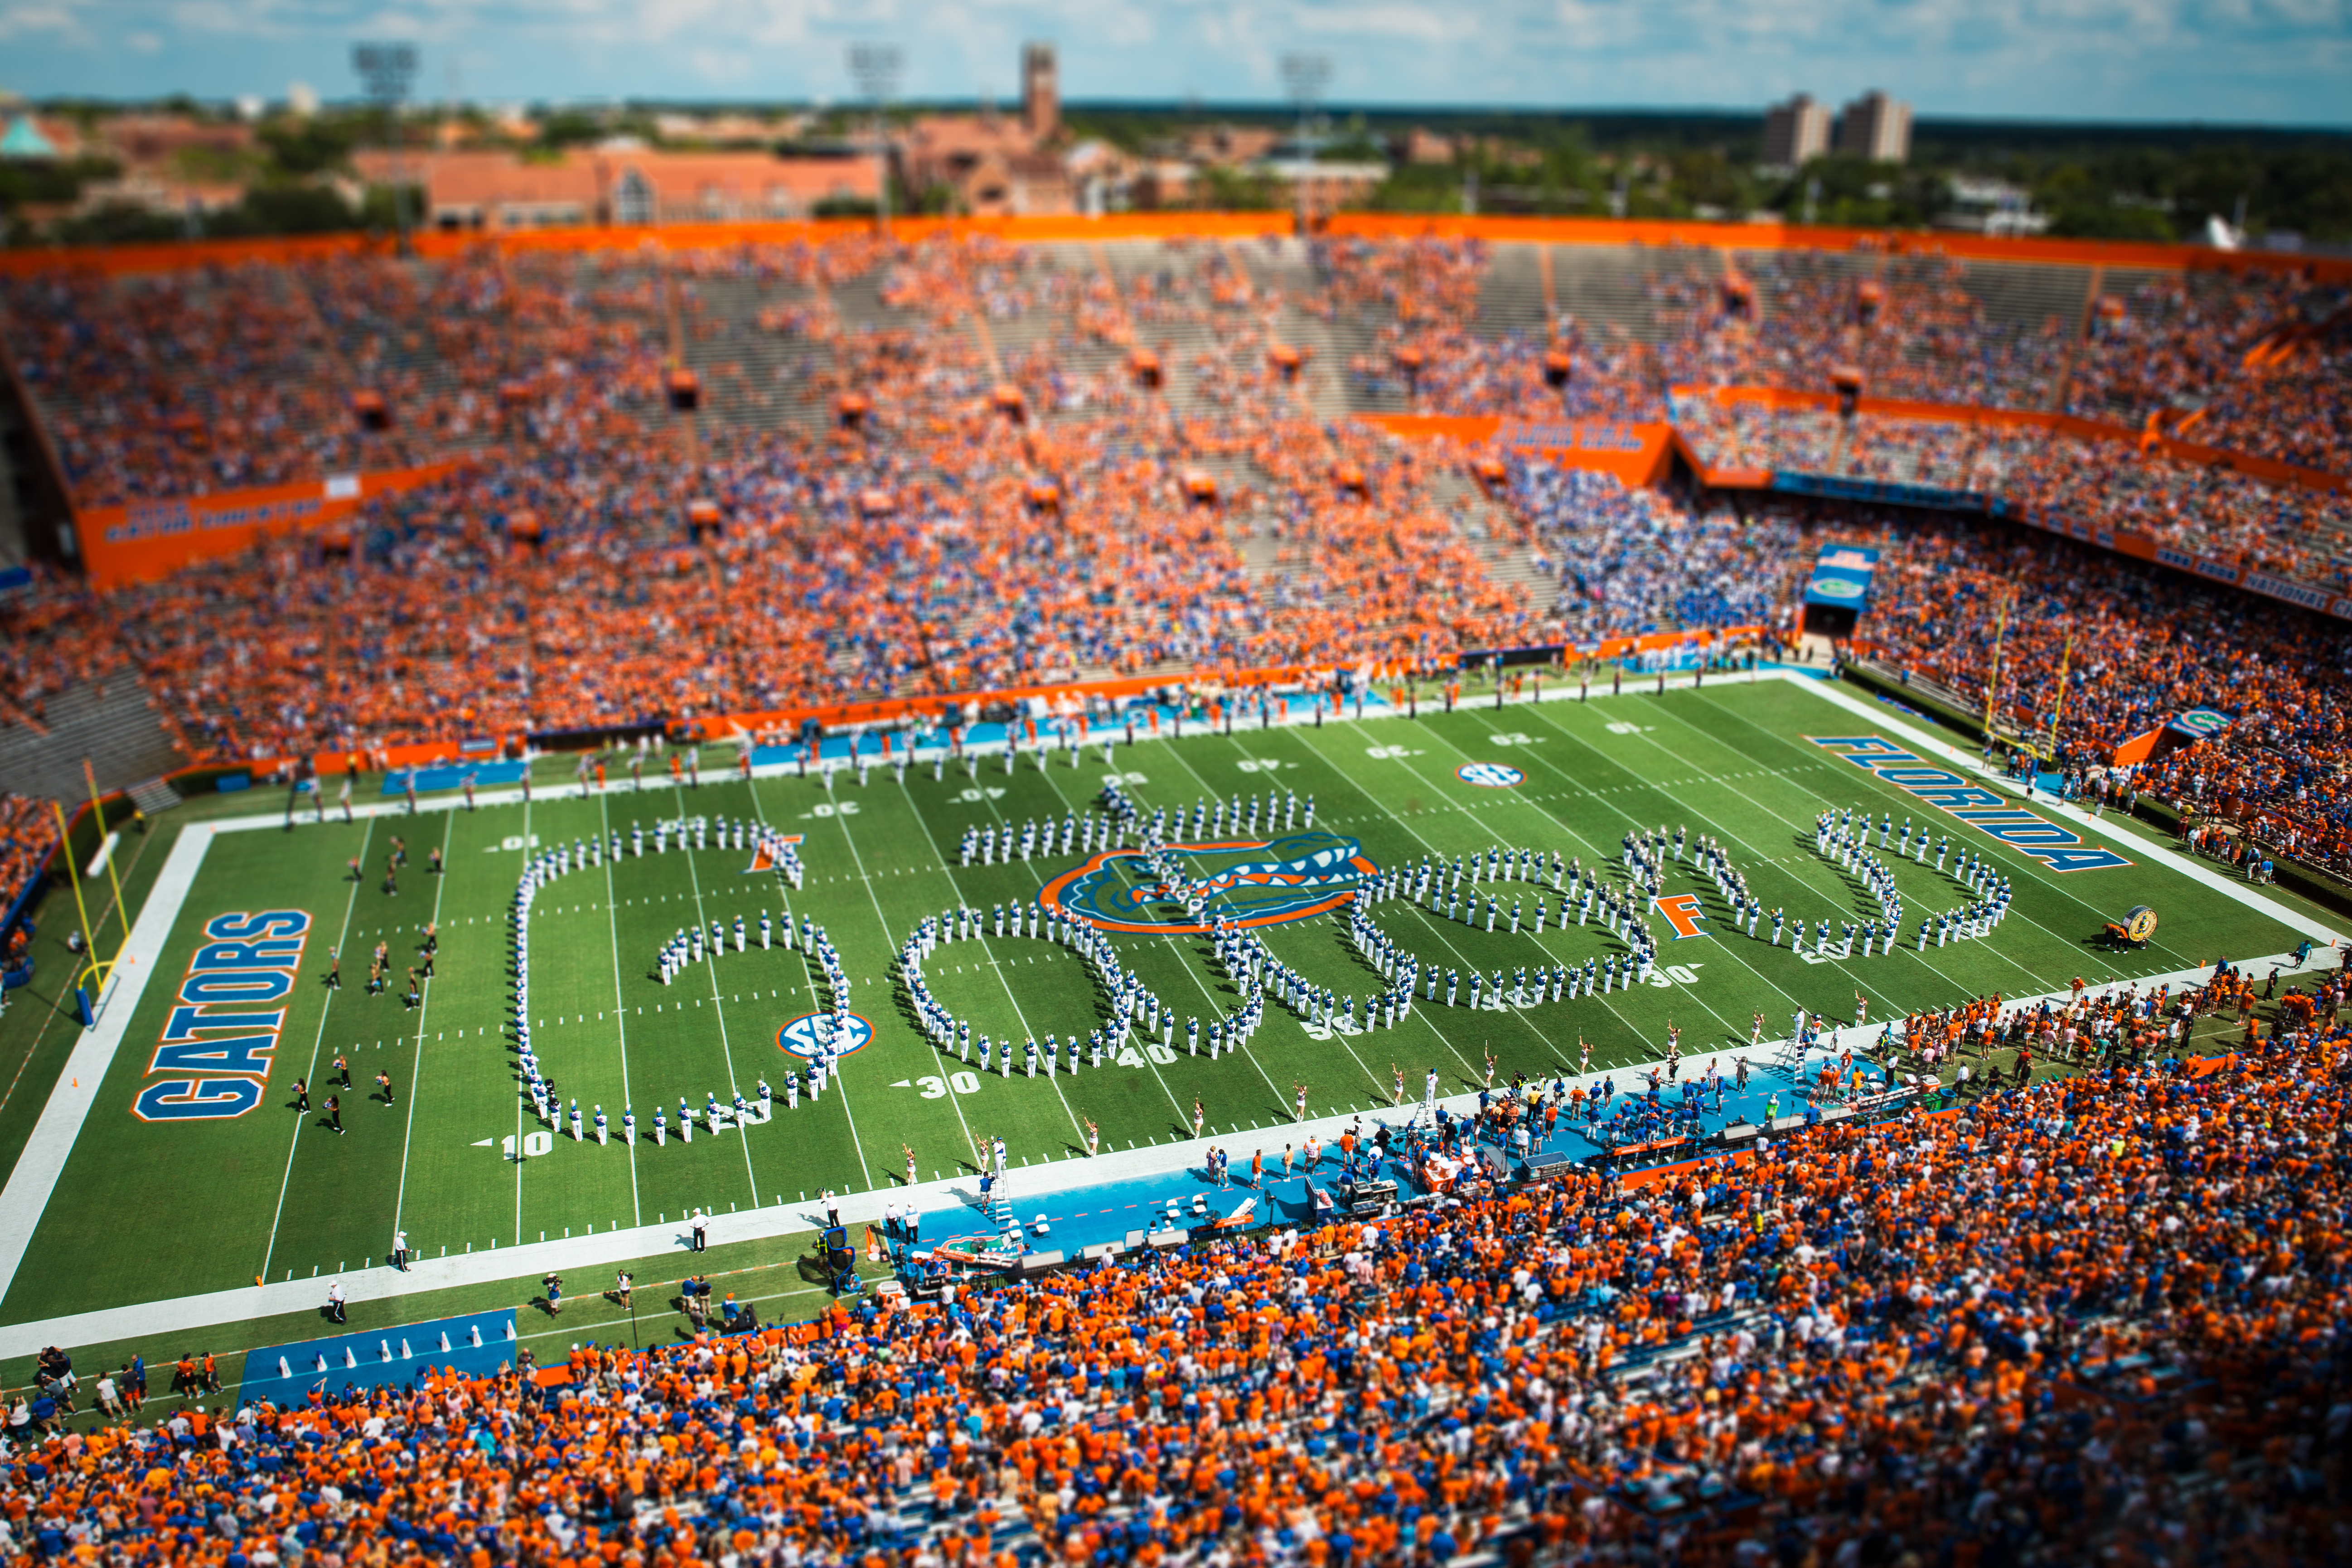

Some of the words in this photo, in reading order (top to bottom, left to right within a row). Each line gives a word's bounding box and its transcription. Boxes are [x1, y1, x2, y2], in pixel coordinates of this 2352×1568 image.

[2246, 574, 2325, 609] NATIONAL
[1458, 763, 1524, 787] SEC
[960, 786, 1007, 802] 40
[1798, 734, 2136, 873] FLORIDA
[813, 801, 861, 817] 30
[1654, 892, 1715, 941] F
[2134, 911, 2147, 921] GATOR
[1645, 965, 1699, 988] 30
[1481, 990, 1536, 1012] 40
[130, 909, 313, 1122] GATORS
[1299, 1016, 1364, 1040] 50
[1117, 1043, 1178, 1069] 40
[916, 1071, 981, 1099] 30
[501, 1131, 553, 1160] 10
